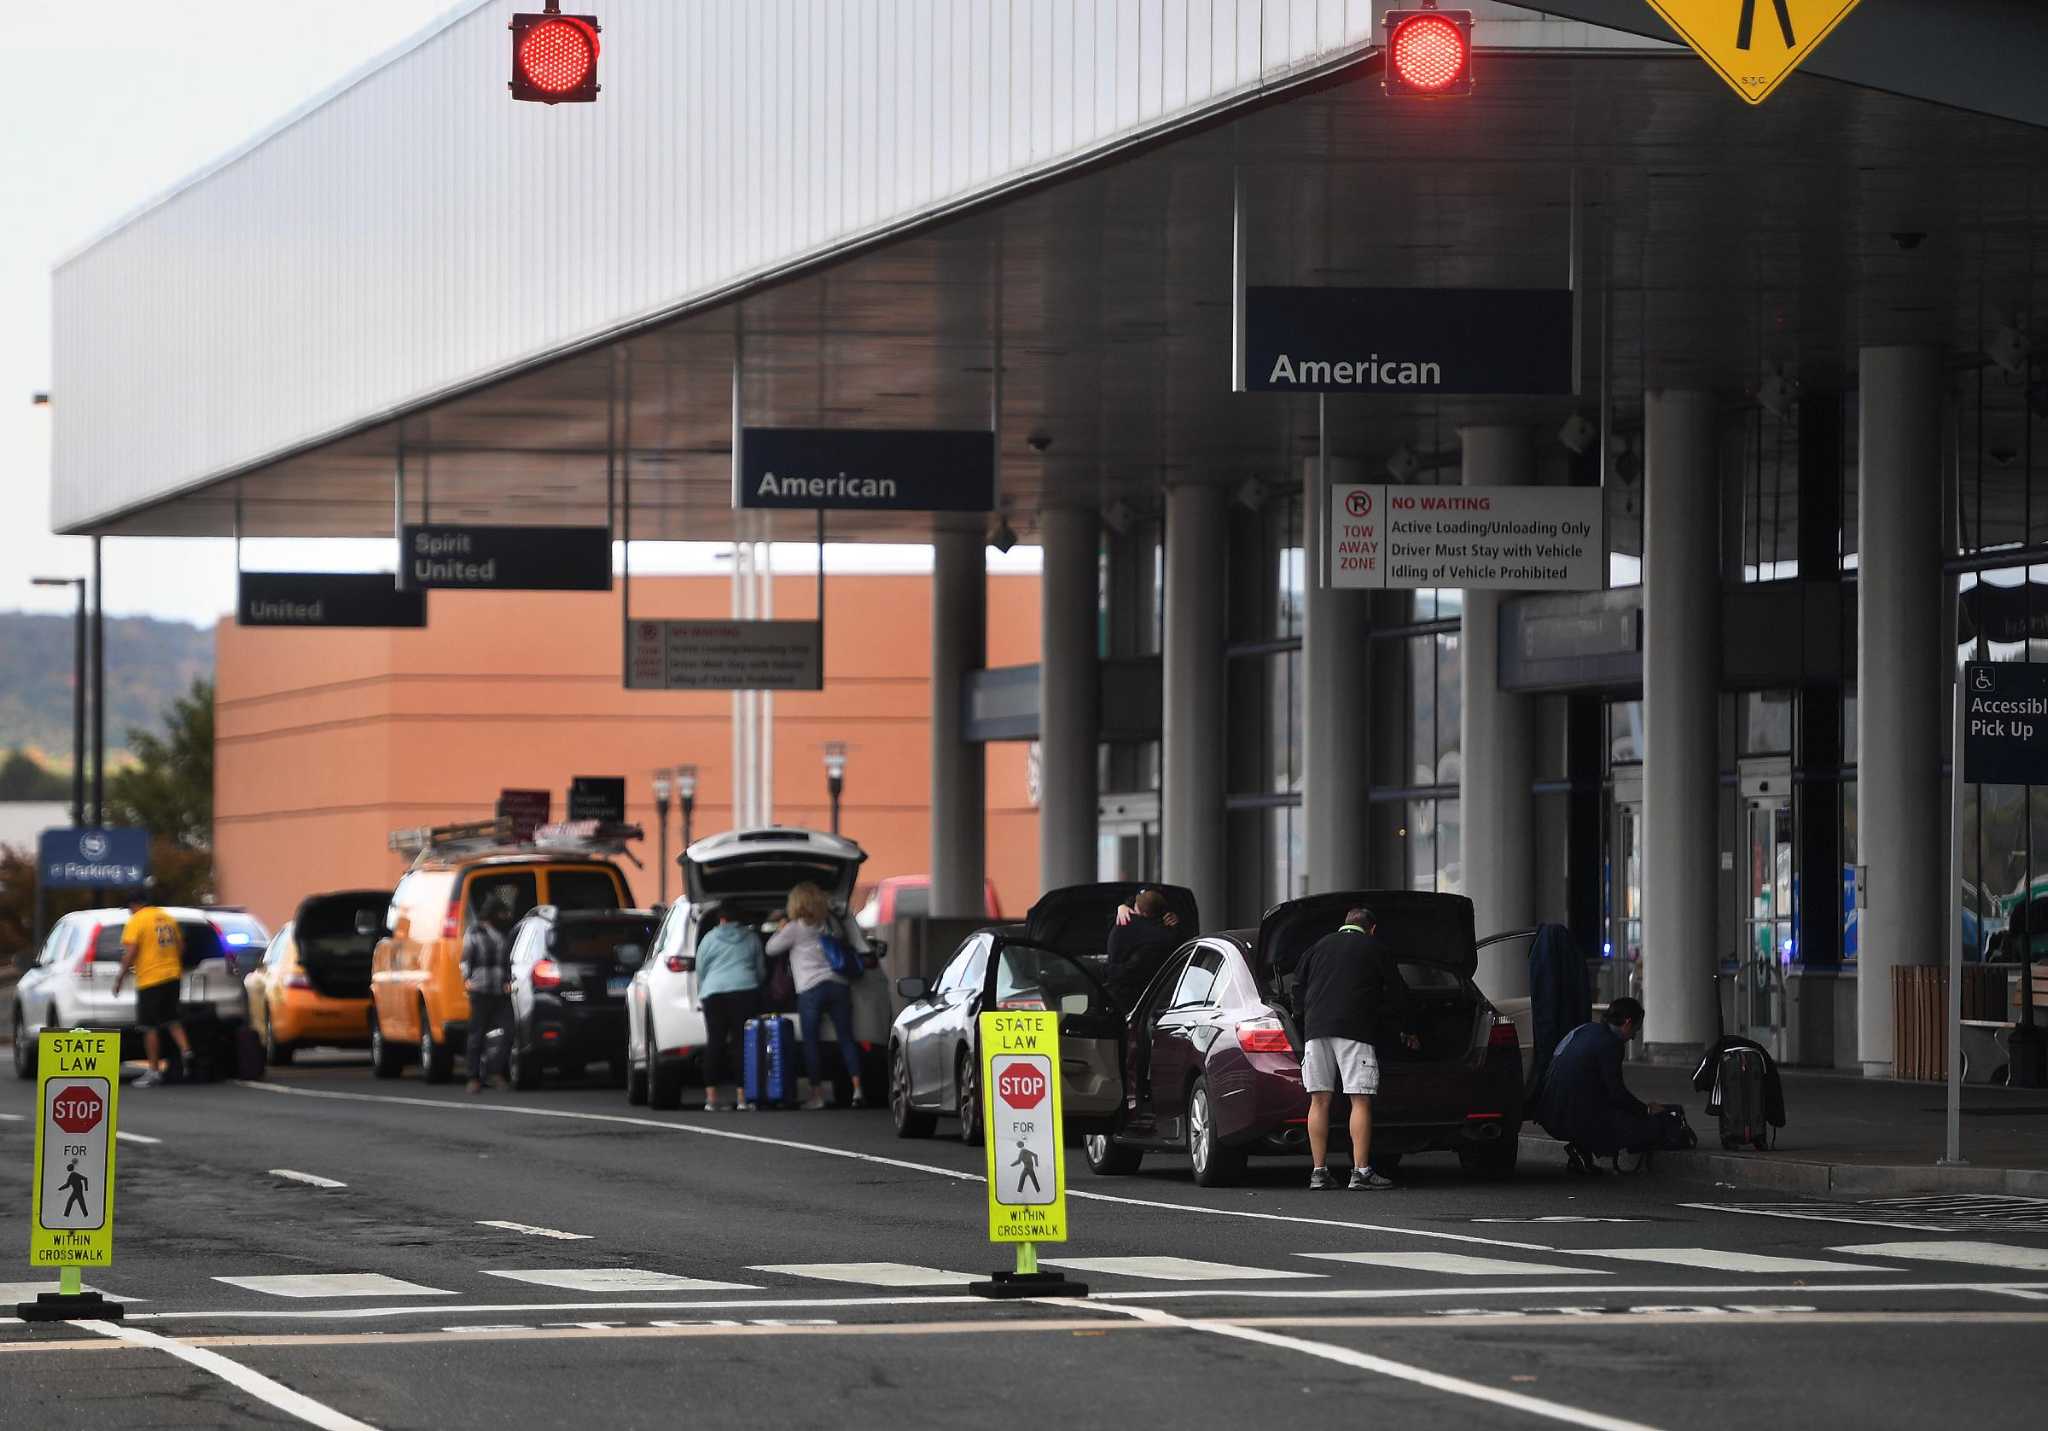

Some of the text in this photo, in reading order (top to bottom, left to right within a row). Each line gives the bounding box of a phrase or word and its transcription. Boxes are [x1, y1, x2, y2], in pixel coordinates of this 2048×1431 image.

[1269, 353, 1440, 384] American
[756, 471, 896, 497] American
[1392, 497, 1490, 510] NO WAITING
[1344, 525, 1374, 537] TOW
[1392, 521, 1591, 537] Active Loading/Unloading Only
[415, 533, 471, 554] Spirit
[1339, 541, 1379, 553] AWAY
[1392, 543, 1583, 560] Driver Must Stay with Vehicle
[415, 559, 495, 581] United
[1340, 557, 1376, 569] ZONE
[1392, 565, 1567, 581] Idling of Vehicle Prohibited
[250, 601, 323, 620] United
[1971, 697, 2048, 715] Accessibl
[1971, 719, 2034, 741] Pick Up
[995, 1018, 1044, 1032] STATE
[53, 1039, 106, 1054] STATE
[1003, 1036, 1037, 1049] LAW
[60, 1058, 97, 1071] LAW
[1001, 1077, 1043, 1095] STOP
[55, 1100, 100, 1119] STOP
[1013, 1122, 1035, 1133] FOR
[63, 1145, 87, 1156] FOR
[1009, 1210, 1046, 1221] WITHIN
[997, 1224, 1058, 1236] CROSSWALK
[53, 1234, 91, 1245] WITHIN
[39, 1249, 103, 1261] CROSSWALK
